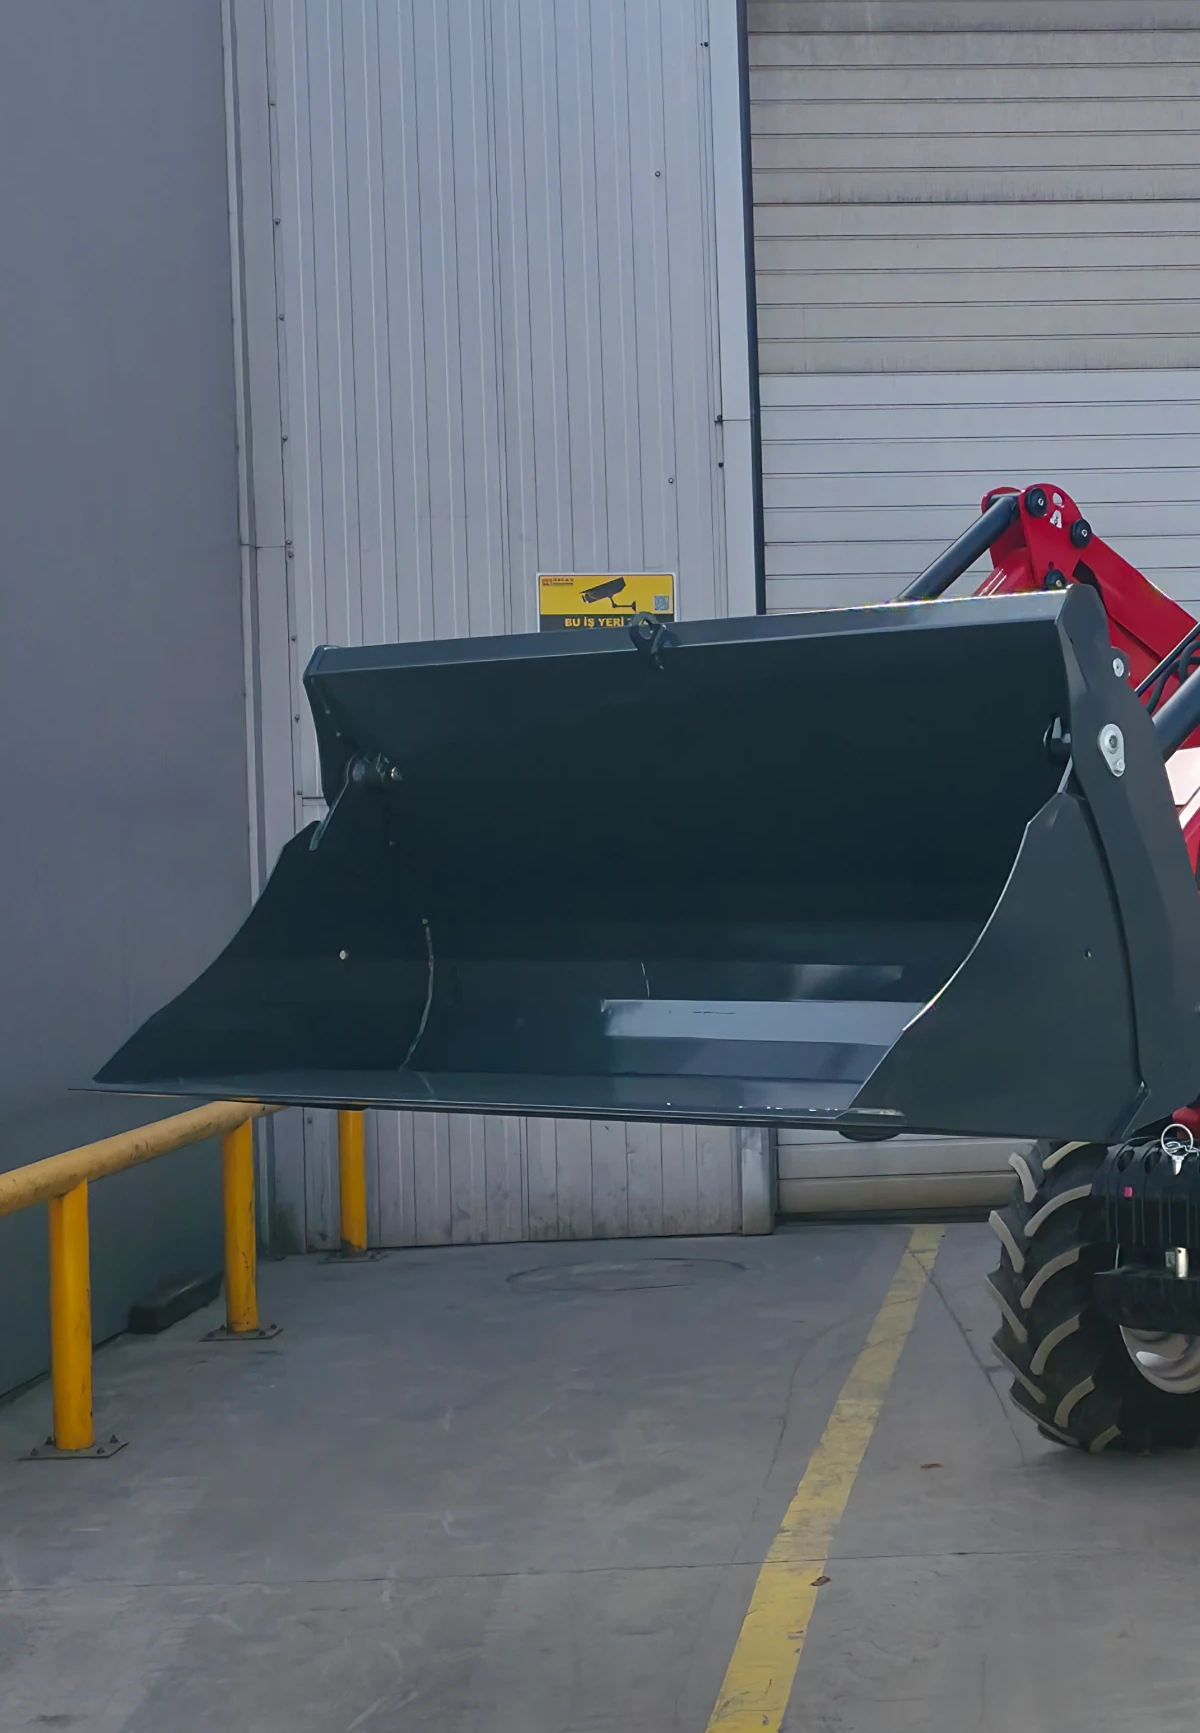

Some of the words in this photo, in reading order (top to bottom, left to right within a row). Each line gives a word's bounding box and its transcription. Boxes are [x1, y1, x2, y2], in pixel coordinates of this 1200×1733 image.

[564, 618, 581, 627] BU
[584, 616, 595, 628] İŞ
[598, 616, 625, 628] YERİ
